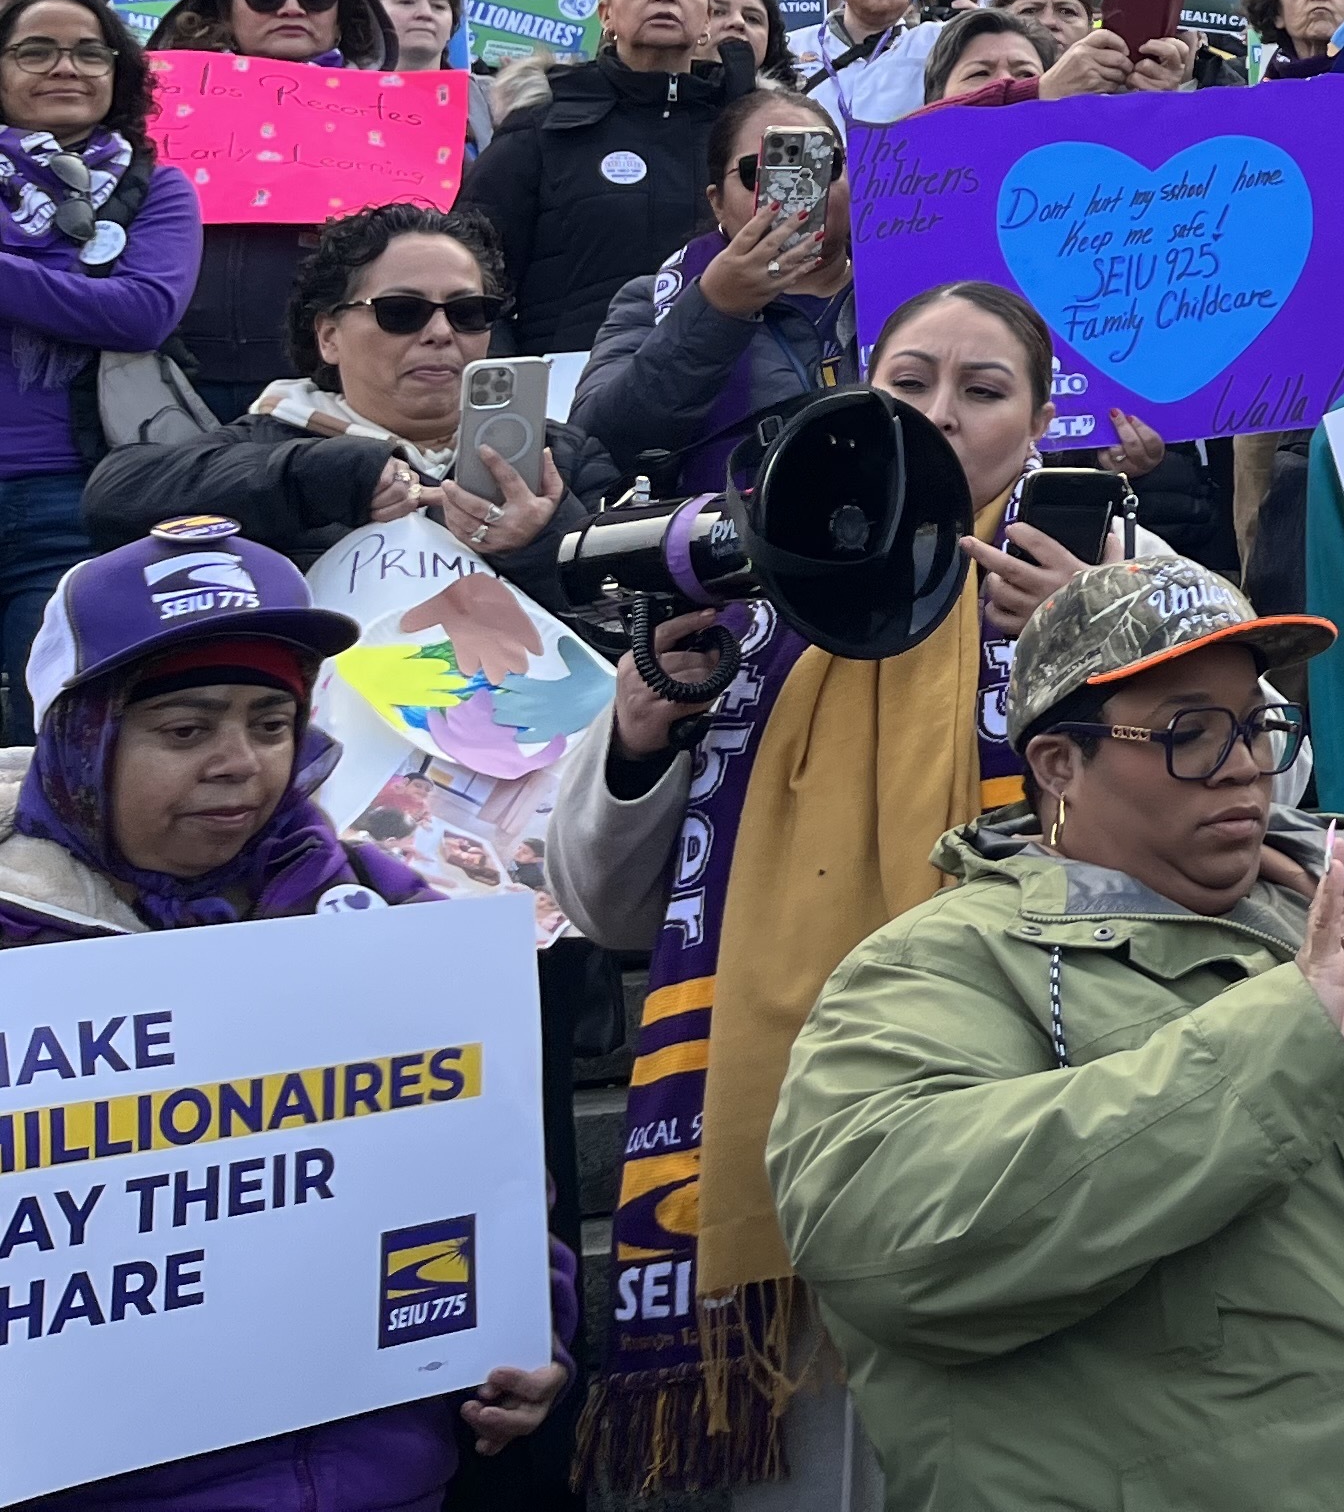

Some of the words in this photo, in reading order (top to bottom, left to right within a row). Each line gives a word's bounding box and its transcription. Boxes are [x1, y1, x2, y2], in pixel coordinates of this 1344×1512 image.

[258, 75, 423, 127] Recortes
[157, 133, 252, 163] Early
[278, 143, 426, 186] Learning
[858, 125, 908, 165] The
[1084, 183, 1124, 218] hurt
[1129, 189, 1156, 221] my
[1231, 160, 1285, 195] home
[857, 208, 944, 245] Center
[1057, 220, 1113, 258] Keep
[1123, 225, 1155, 247] me
[1074, 254, 1158, 304] SEIU
[1165, 242, 1220, 287] 925
[1062, 297, 1144, 363] Family
[1156, 283, 1279, 330] Childcare
[1212, 374, 1309, 435] Walla
[160, 592, 214, 620] SEIU
[217, 591, 260, 610] 775
[1146, 579, 1238, 619] Union
[1111, 724, 1151, 742] GUCCI
[0, 1010, 175, 1087] AKE
[0, 1046, 465, 1173] ILLIONAIRES
[625, 1116, 682, 1156] LOCAL
[126, 1147, 335, 1234] THEIR
[387, 1299, 432, 1332] SEIU
[430, 1292, 470, 1321] 775
